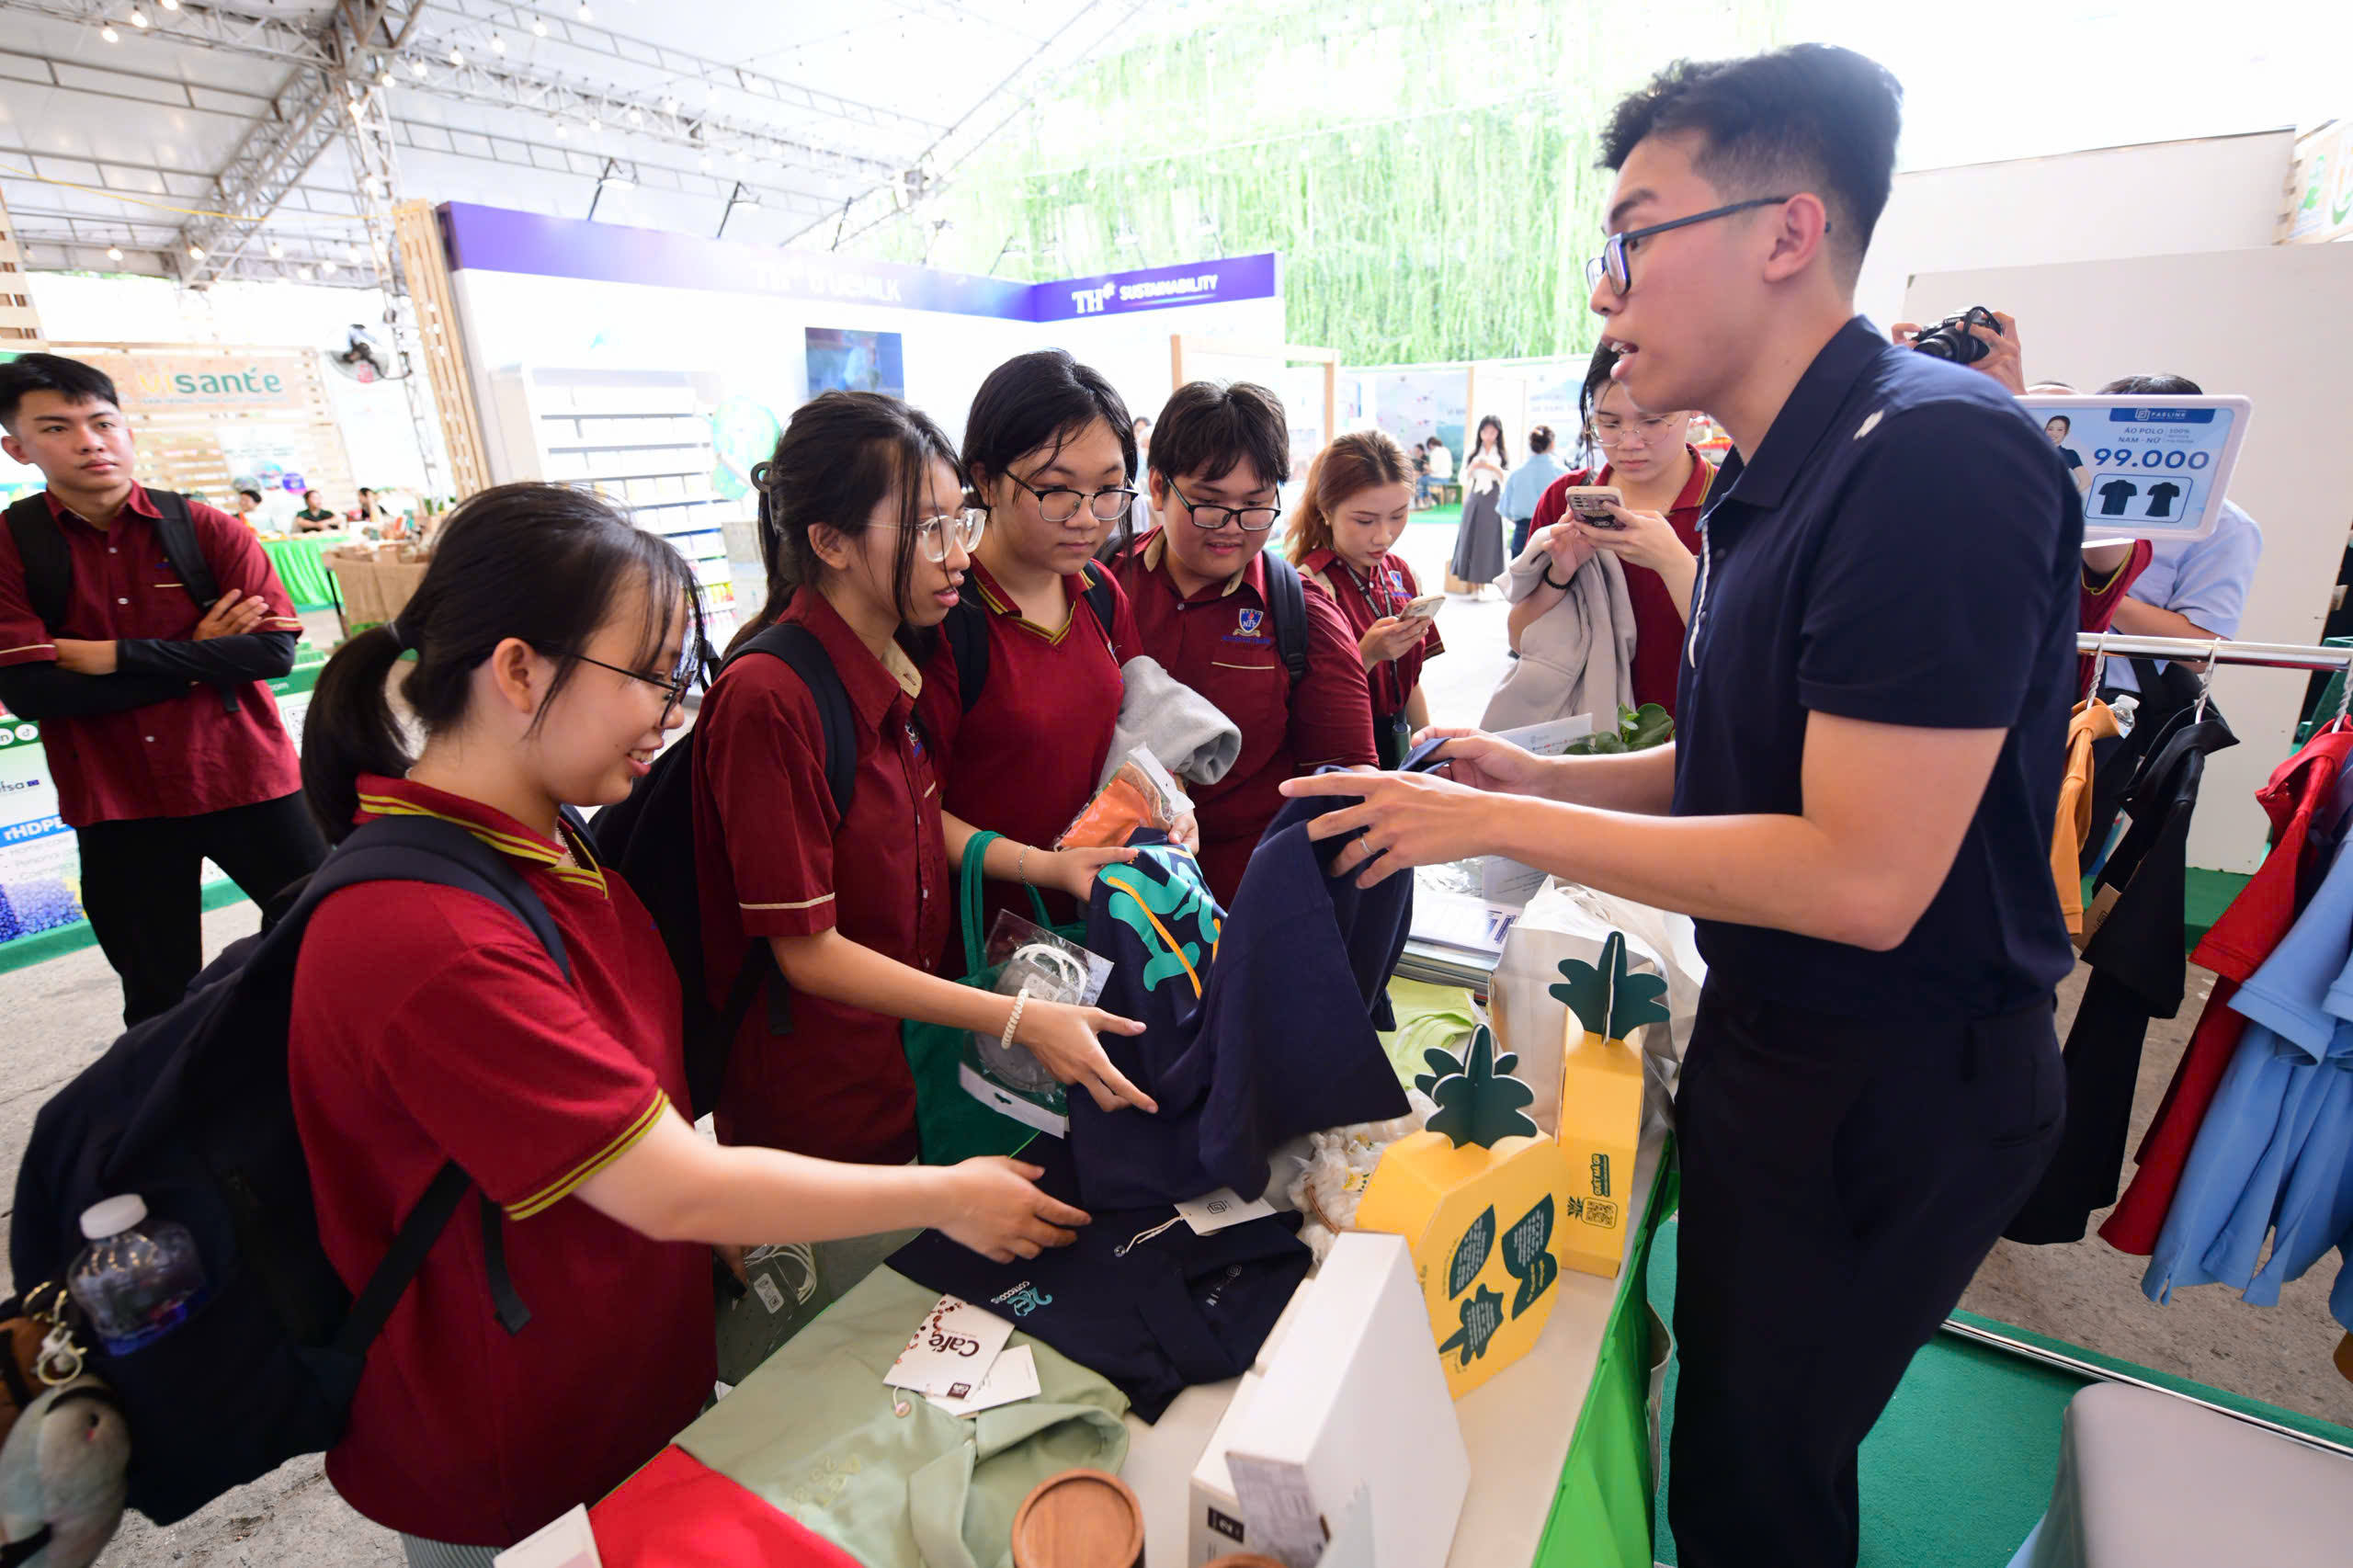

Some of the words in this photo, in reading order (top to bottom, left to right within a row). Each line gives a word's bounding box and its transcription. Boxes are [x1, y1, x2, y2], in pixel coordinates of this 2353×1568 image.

[1072, 288, 1104, 313] TH
[1120, 273, 1219, 301] SUSTAINABILITY
[2140, 427, 2164, 436] POLO
[2094, 448, 2210, 470] 99.000
[929, 1333, 980, 1358] Café
